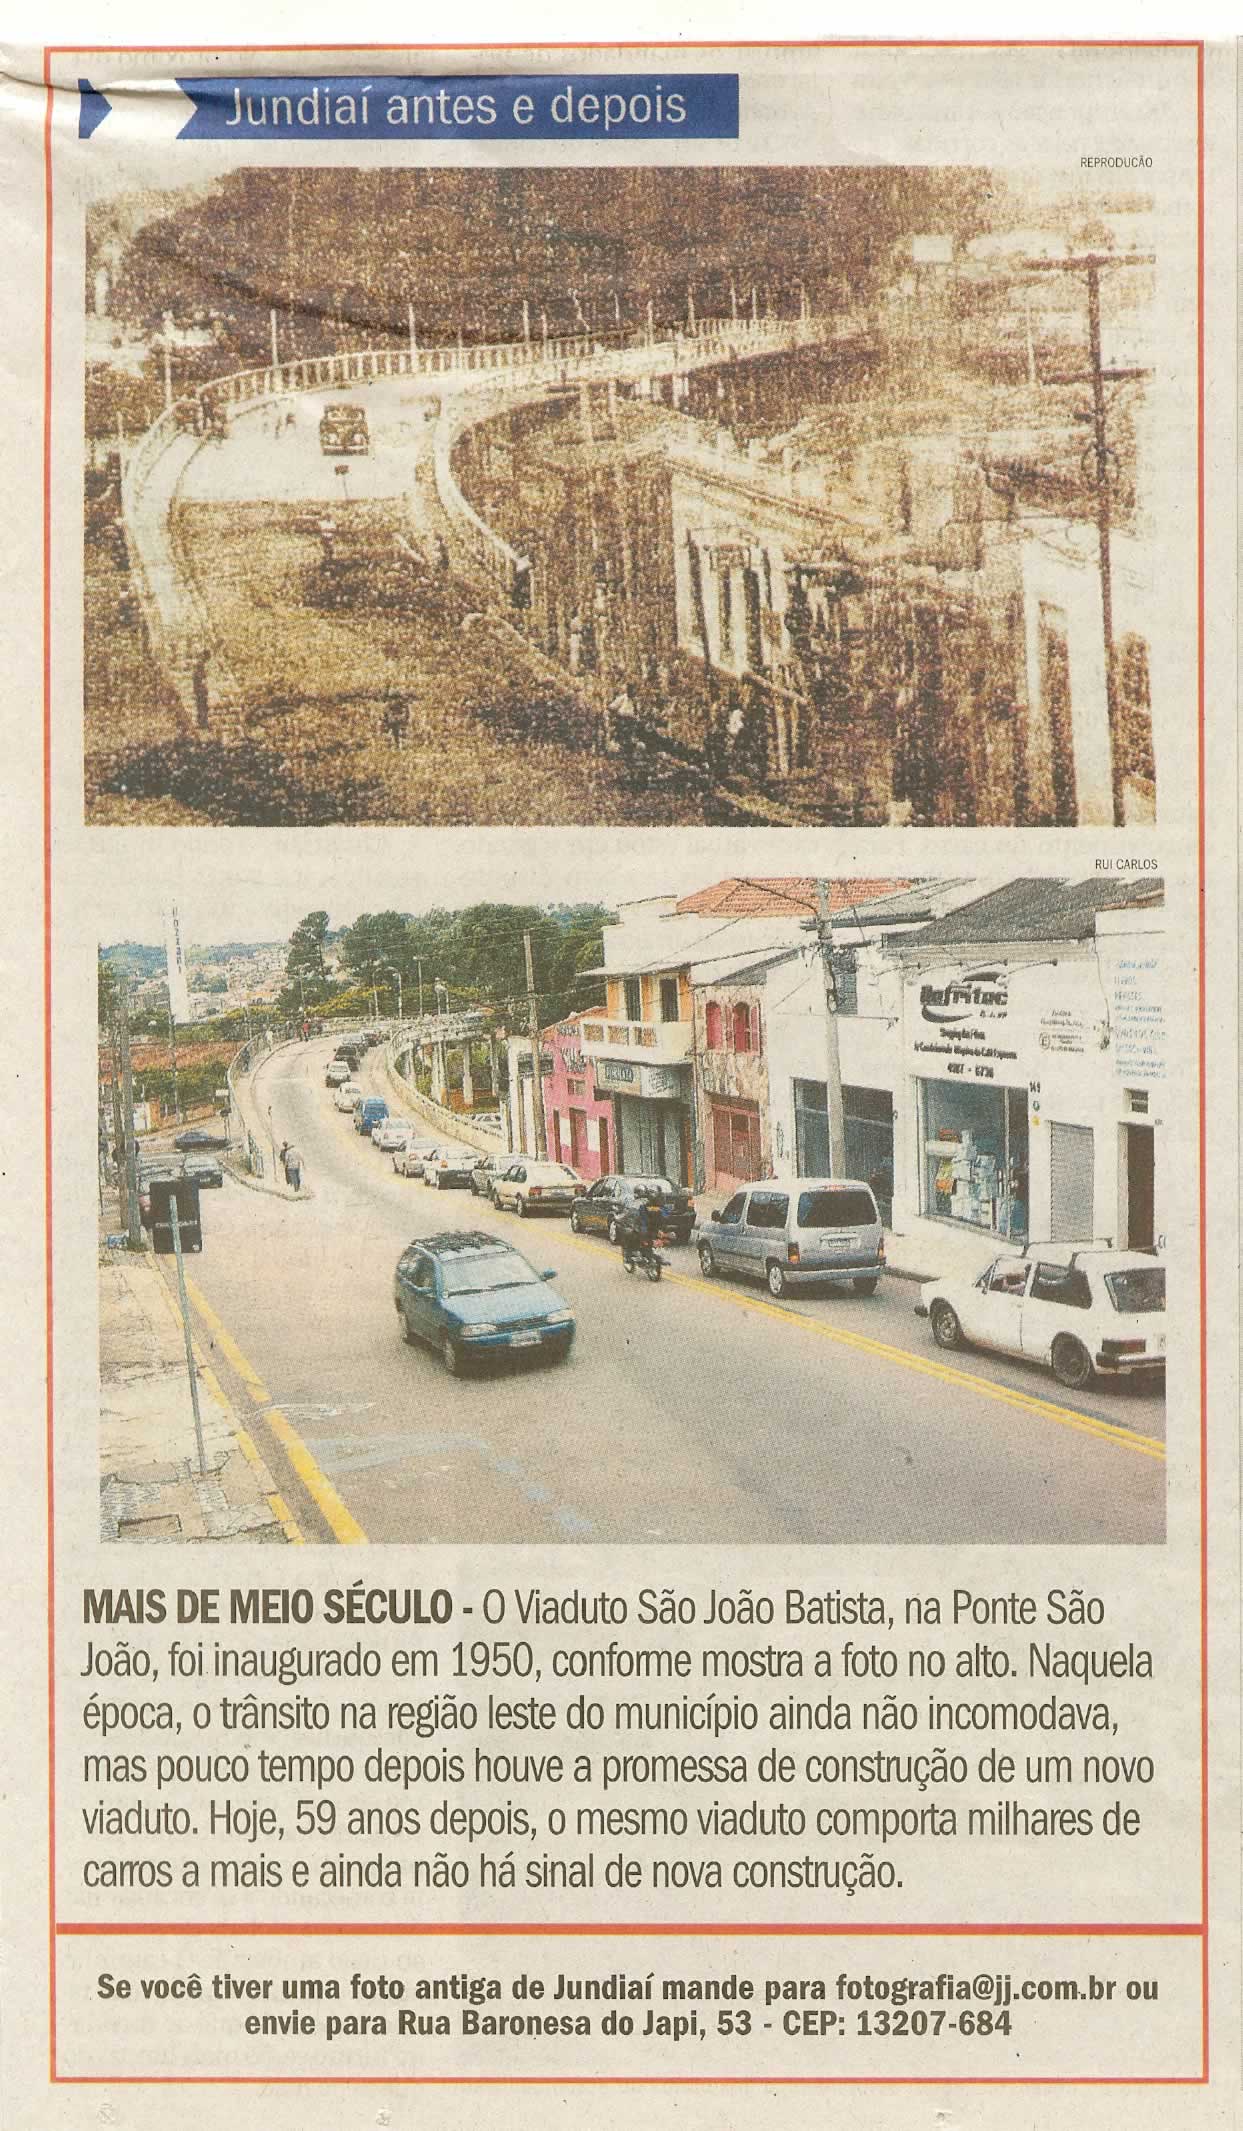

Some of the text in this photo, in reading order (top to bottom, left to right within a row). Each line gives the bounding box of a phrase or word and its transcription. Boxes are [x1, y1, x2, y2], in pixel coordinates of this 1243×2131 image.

[226, 85, 687, 130] Jundiaí antes e depois
[1095, 858, 1158, 870] RUI CARLOS
[83, 1588, 167, 1624] MAIS
[177, 1589, 220, 1624] DE
[230, 1588, 314, 1624] MEIO
[323, 1579, 453, 1625] SÉCULO
[482, 1588, 506, 1625] O
[514, 1589, 628, 1625] Viaduto
[637, 1588, 696, 1625] São
[703, 1588, 775, 1625] João
[785, 1589, 894, 1631] Batista,
[905, 1597, 941, 1625] na
[953, 1589, 1037, 1625] Ponte
[1046, 1589, 1105, 1625] São
[80, 1641, 1153, 1686] João, foi inaugurado em 1950, conforme mostra a foto no alto. Naquela
[83, 1692, 1118, 1739] época, o trânsito na região leste do município ainda não incomodava,
[84, 1747, 1155, 1792] mas pouco tempo depois houve a promessa de construção de um novo
[82, 1799, 1141, 1844] viaduto. Hoje, 59 anos depois, o mesmo viaduto comporta milhares de
[83, 1850, 903, 1897] carros a mais e ainda não há sinal de nova construção.
[97, 1971, 1158, 2007] Se você tiver uma foto antiga de Jundiaí mande para fotografia@jj.com.br ou
[244, 2009, 316, 2035] envie
[326, 2015, 387, 2041] para
[398, 2009, 451, 2036] Rua
[462, 2009, 591, 2036] Baronesa
[601, 2009, 634, 2036] do
[642, 2009, 706, 2042] Japi,
[716, 2009, 752, 2036] 53
[782, 2009, 845, 2036] CEP:
[857, 2009, 1013, 2036] 13207-684
